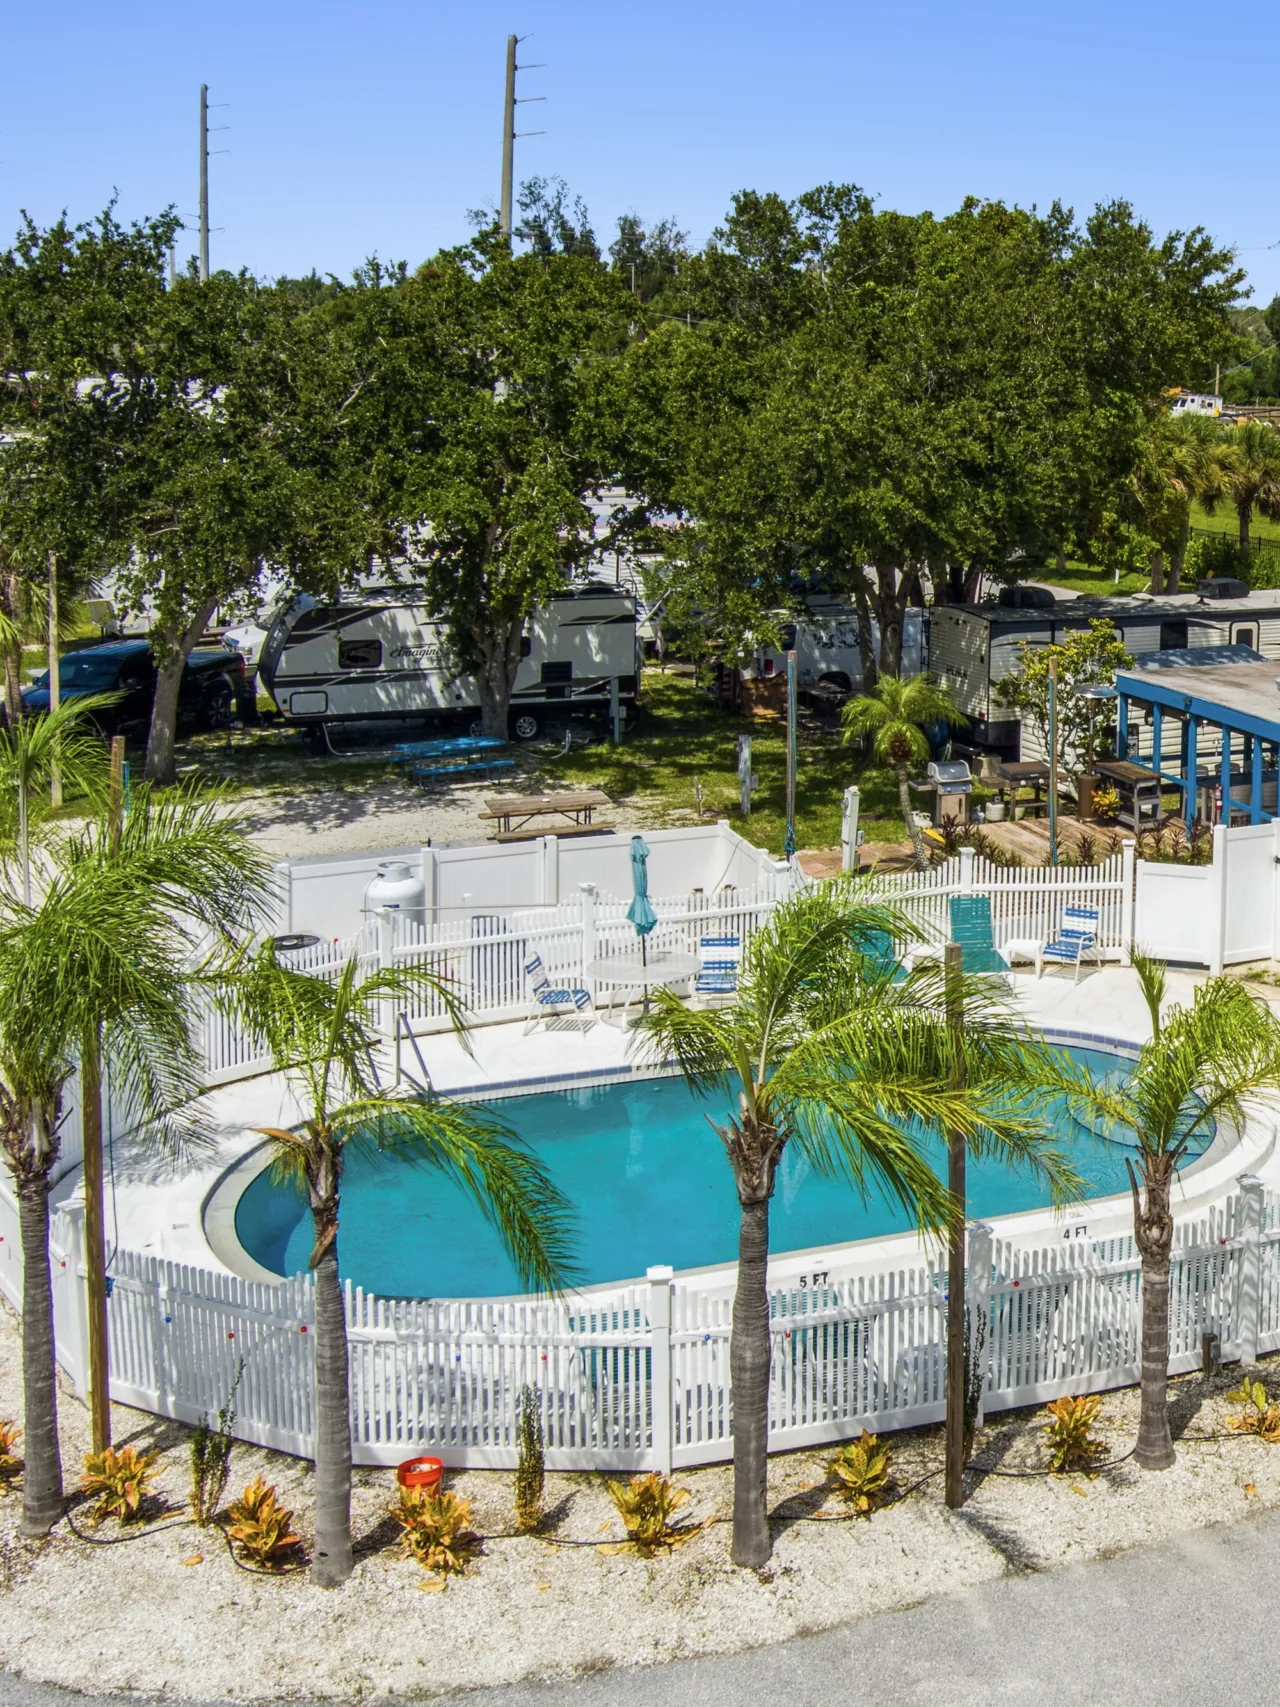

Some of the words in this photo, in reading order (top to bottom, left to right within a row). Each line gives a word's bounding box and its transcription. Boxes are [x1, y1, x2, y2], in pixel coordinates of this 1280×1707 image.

[1063, 1228, 1070, 1239] 4
[1075, 1225, 1087, 1238] FT
[800, 1275, 807, 1289] 5
[812, 1271, 829, 1286] FT
